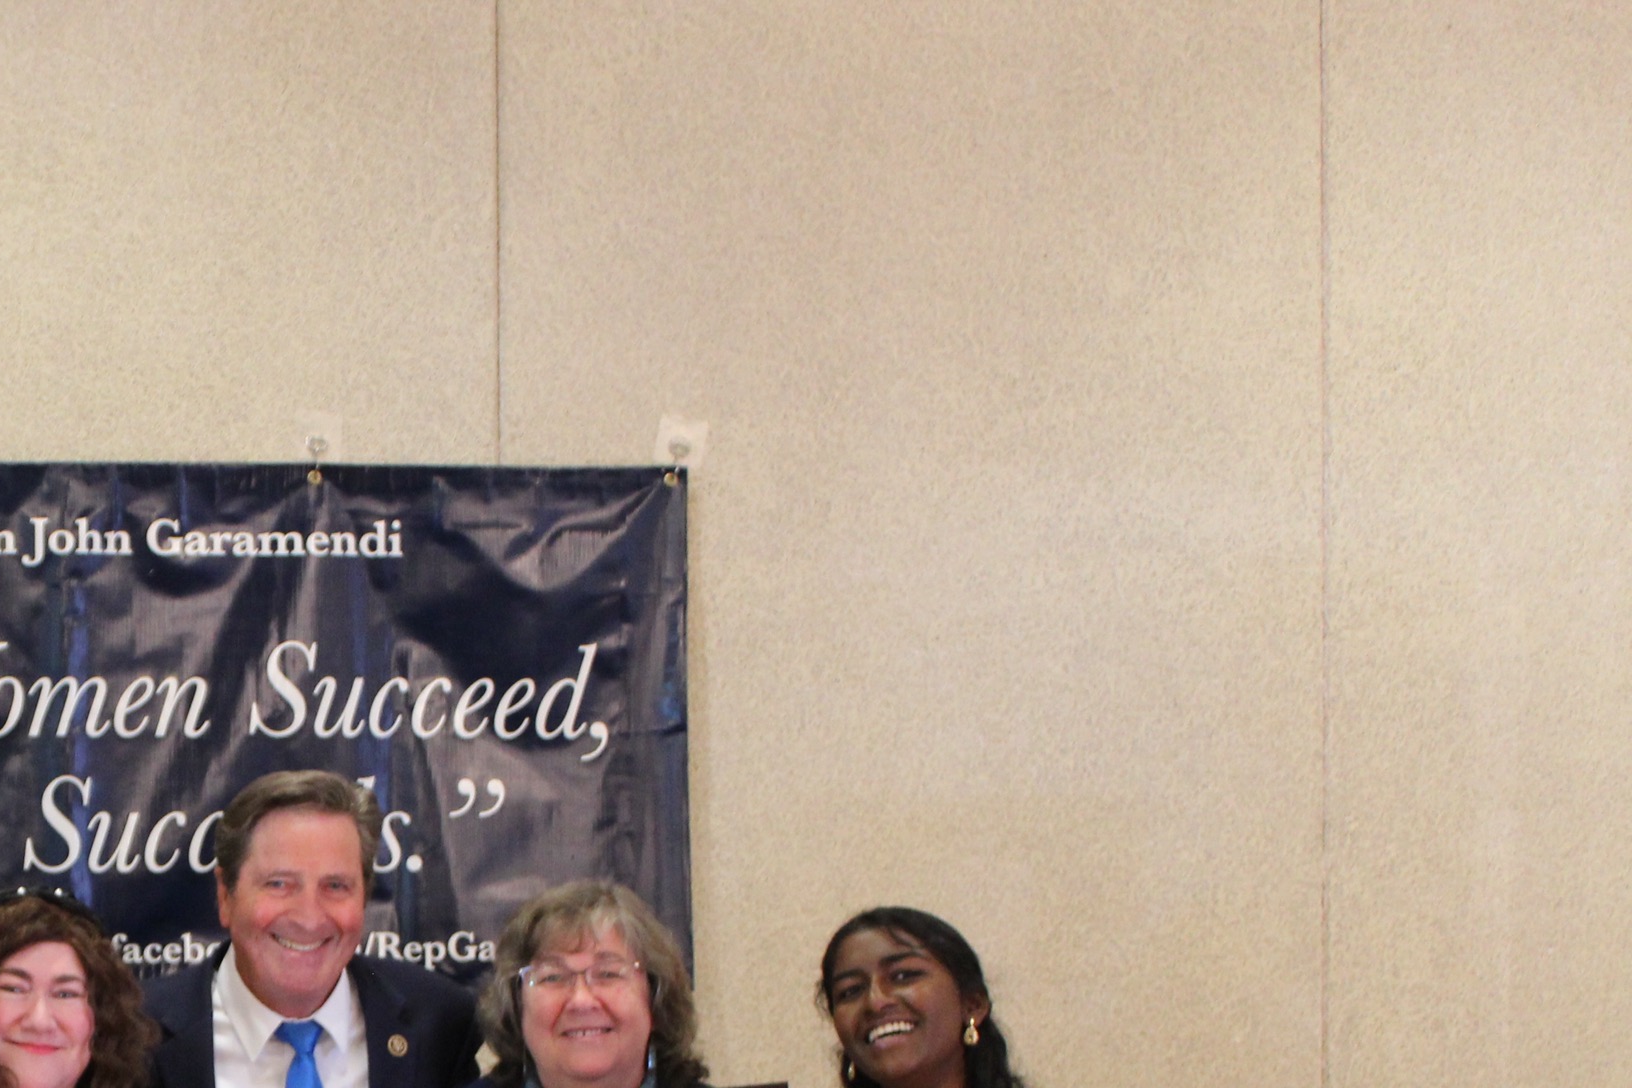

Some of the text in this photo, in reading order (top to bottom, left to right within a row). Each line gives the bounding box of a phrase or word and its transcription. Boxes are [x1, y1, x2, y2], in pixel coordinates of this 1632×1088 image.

[21, 516, 134, 568] John
[145, 517, 404, 559] Garamendi
[248, 639, 610, 762] Succeed,
